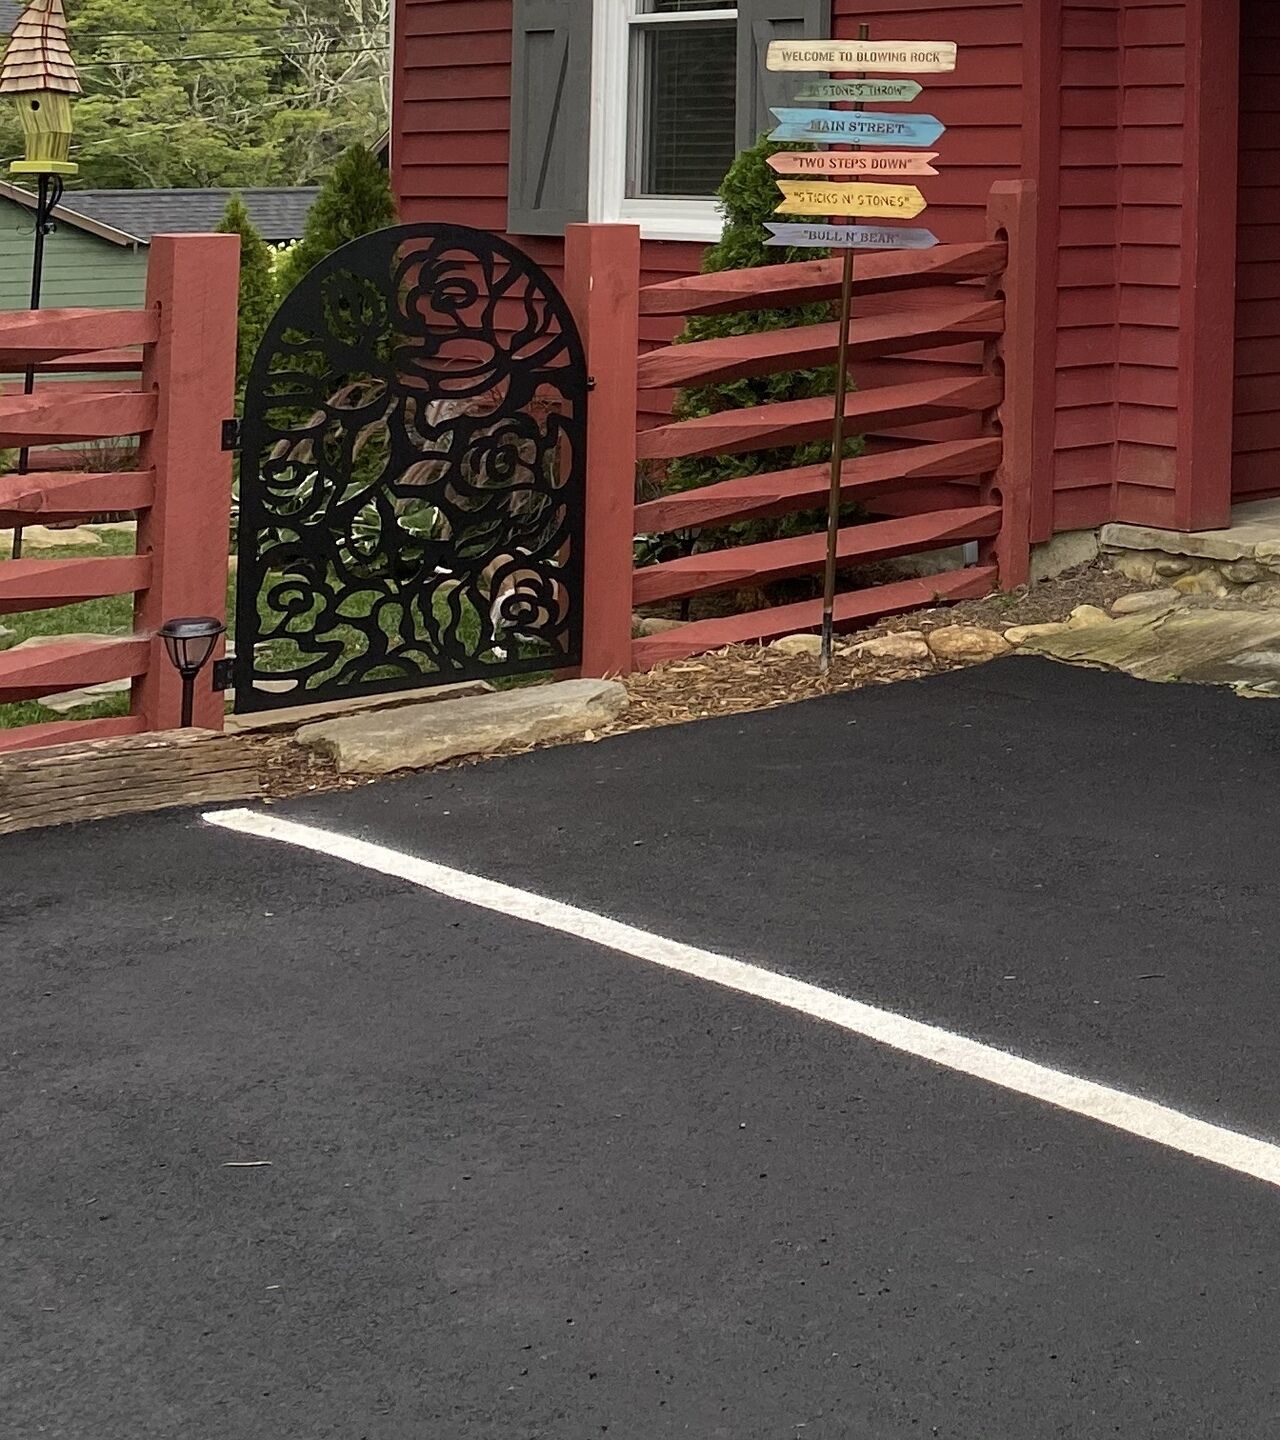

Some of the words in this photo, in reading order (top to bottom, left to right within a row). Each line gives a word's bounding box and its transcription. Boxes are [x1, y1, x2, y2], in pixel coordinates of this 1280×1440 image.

[782, 50, 835, 62] WELCOME
[839, 51, 853, 62] TO
[856, 51, 907, 63] BLOWING
[910, 51, 941, 63] ROCK
[810, 119, 845, 132] MAIN
[848, 121, 905, 135] STREET
[829, 157, 867, 169] STEPS
